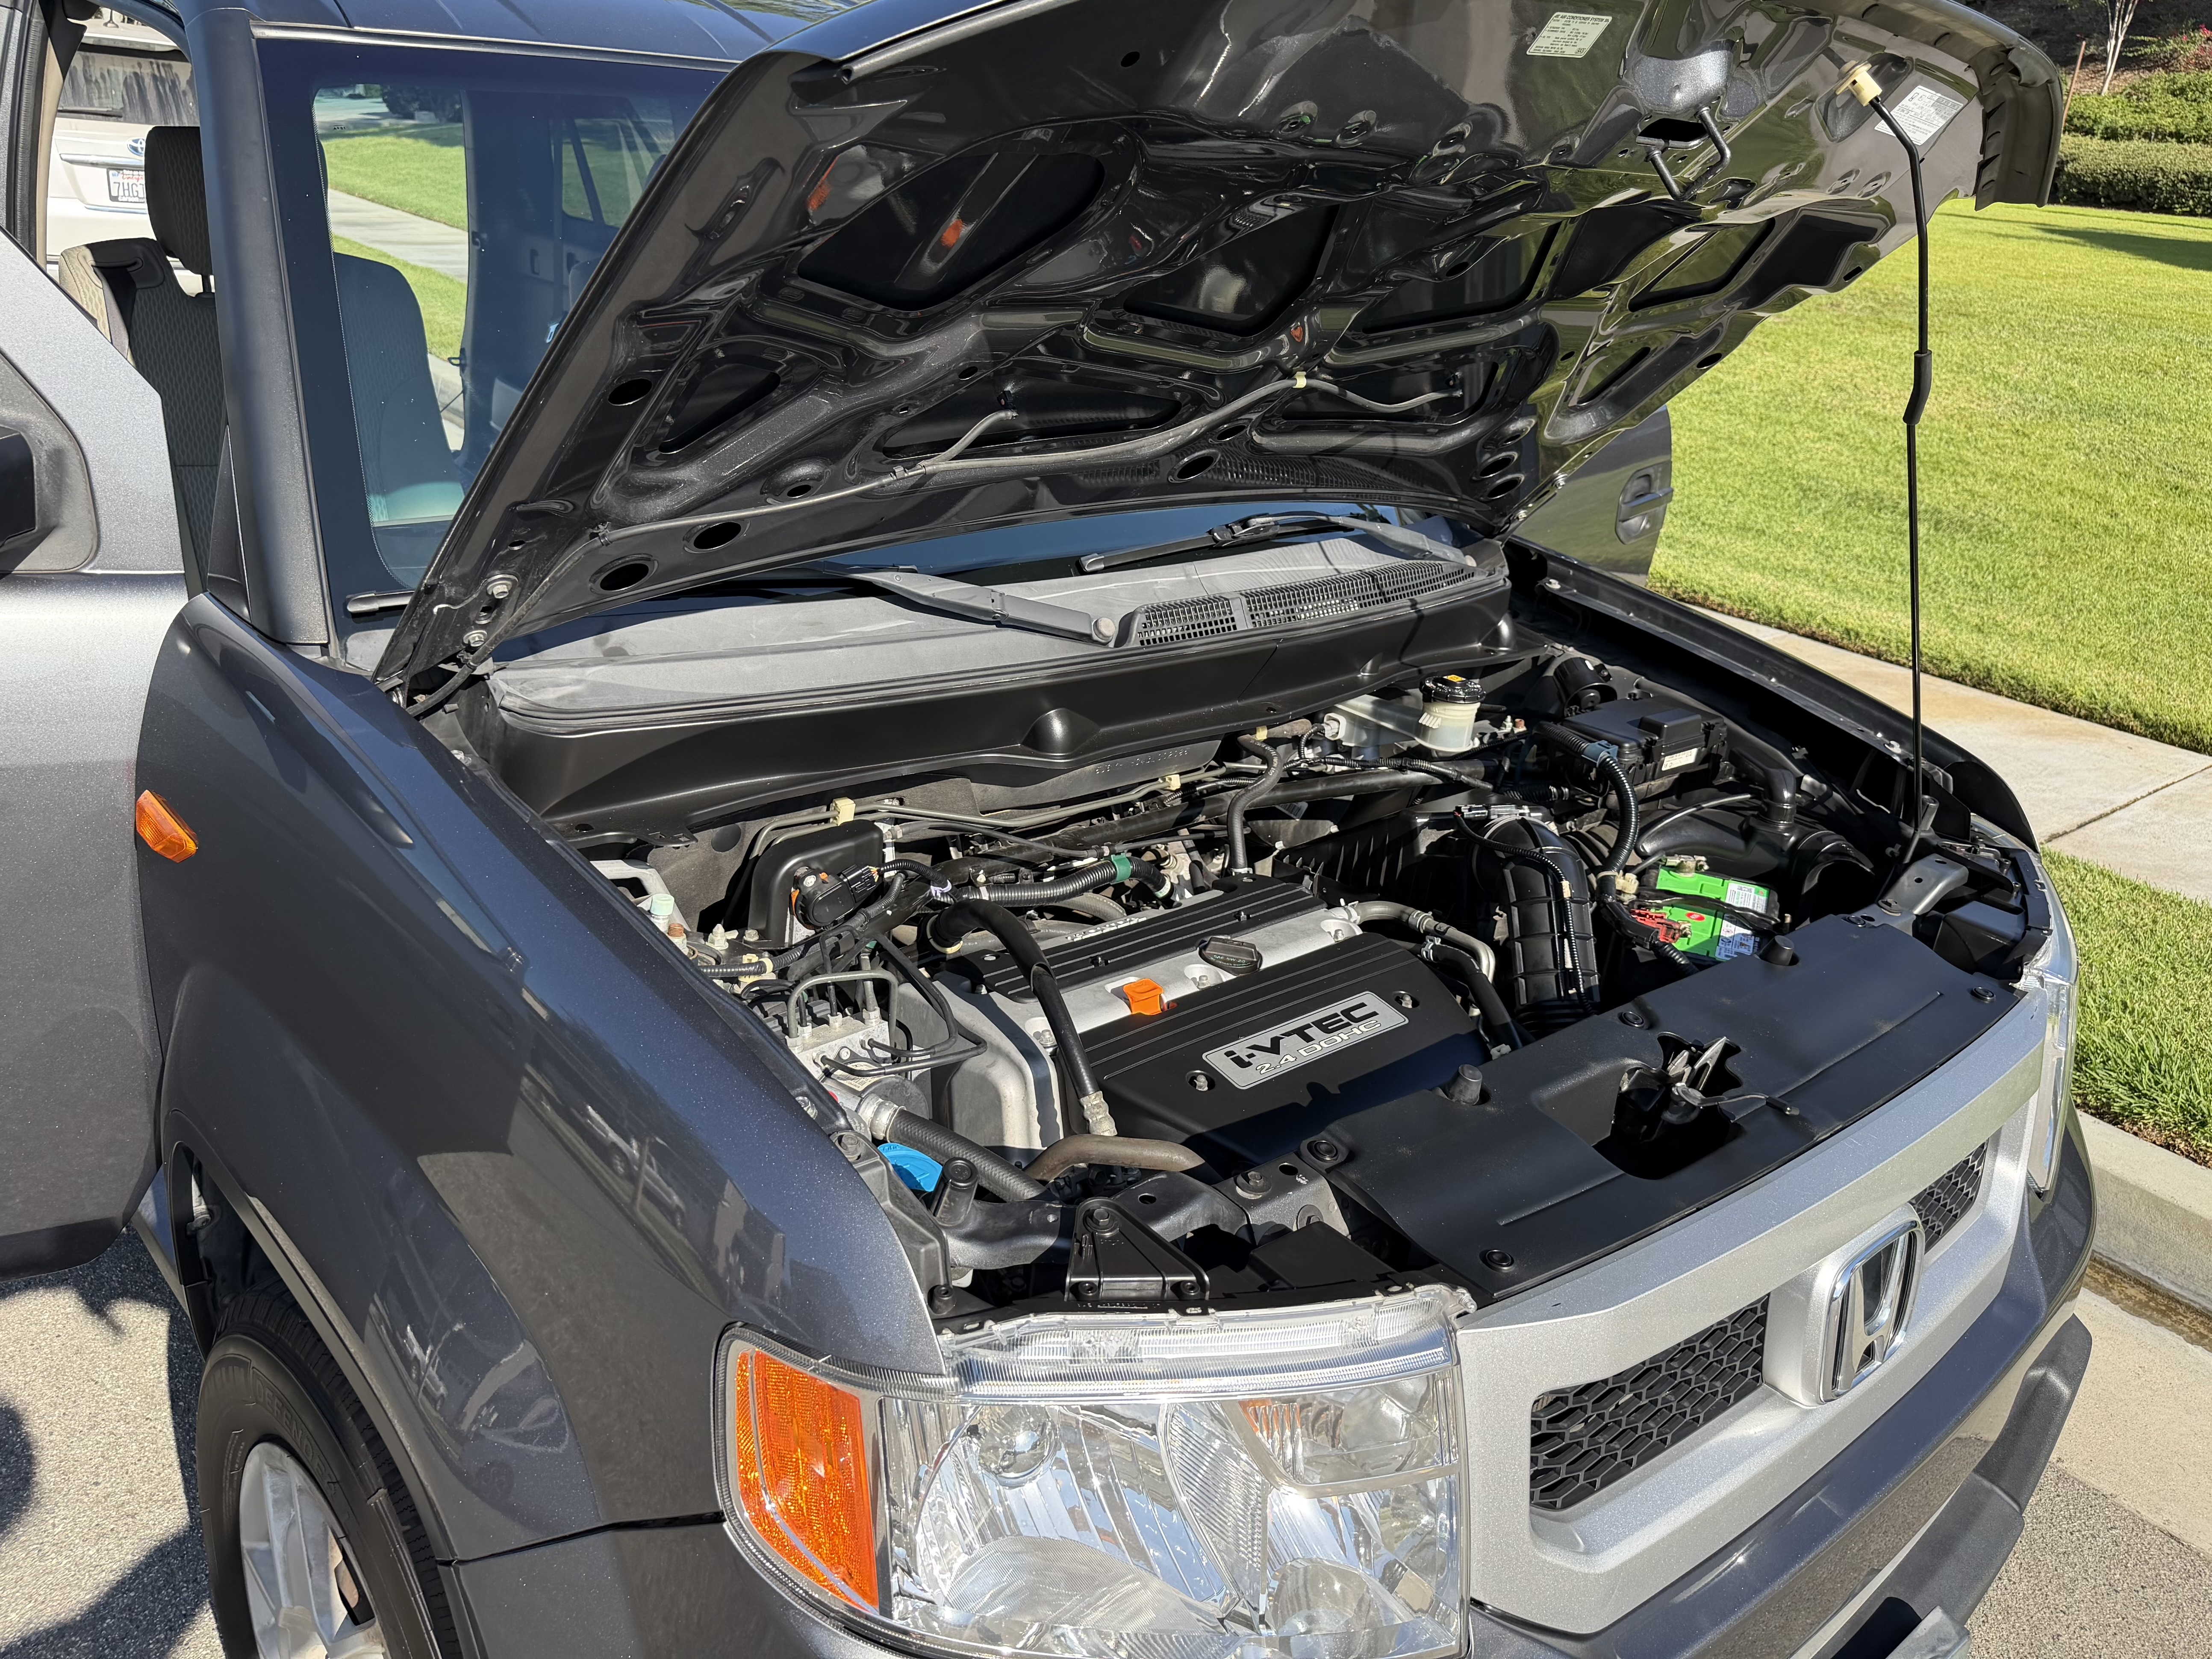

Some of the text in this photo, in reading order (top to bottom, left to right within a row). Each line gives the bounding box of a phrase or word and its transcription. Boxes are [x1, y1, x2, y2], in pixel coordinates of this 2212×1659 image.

[1224, 1002, 1379, 1069] i-VTEC
[1255, 1020, 1381, 1075] 2.4 DOHC
